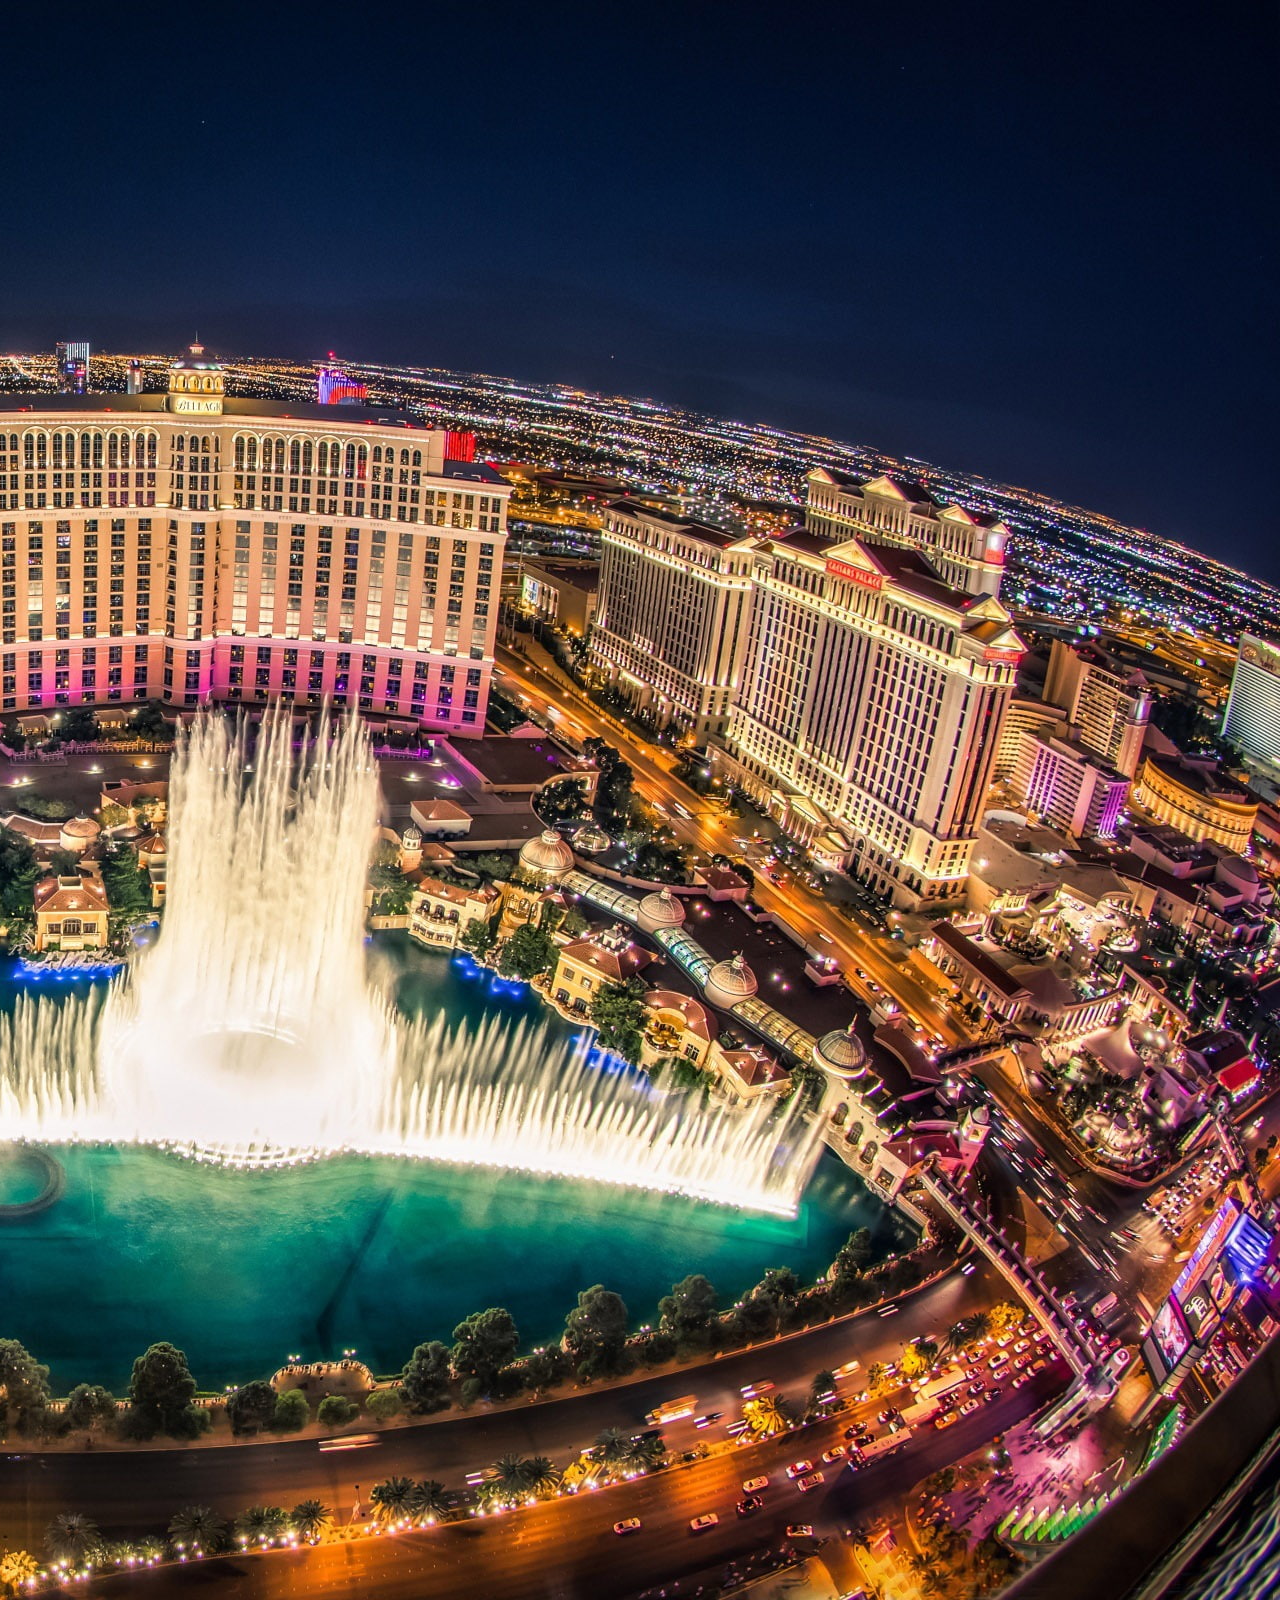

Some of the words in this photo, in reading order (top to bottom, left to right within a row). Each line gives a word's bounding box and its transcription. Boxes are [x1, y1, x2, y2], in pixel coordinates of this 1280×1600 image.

[175, 400, 221, 413] BELLAGI
[828, 561, 855, 578] CAESARS
[855, 571, 881, 588] PALACE
